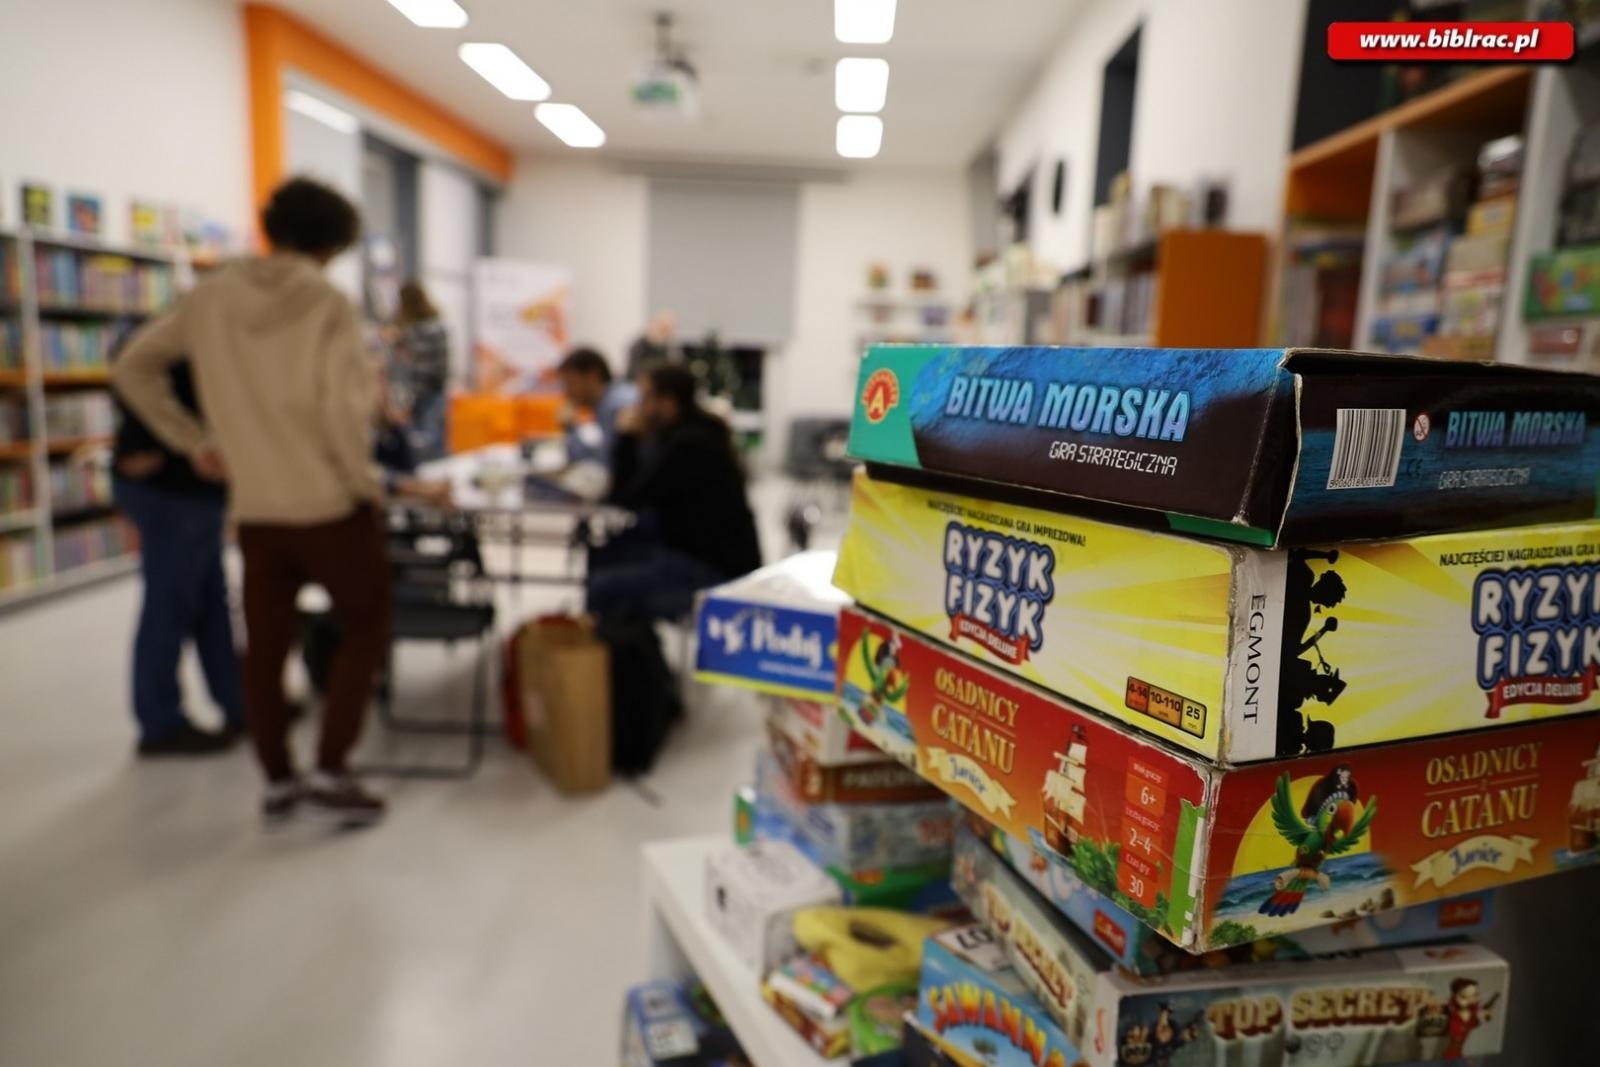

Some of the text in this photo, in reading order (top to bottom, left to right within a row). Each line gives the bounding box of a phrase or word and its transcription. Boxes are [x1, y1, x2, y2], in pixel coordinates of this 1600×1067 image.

[946, 376, 1035, 424] BITWA
[1037, 382, 1191, 442] MORSKA
[1445, 411, 1586, 448] BITWA MORSKA
[1049, 441, 1178, 476] GRA STRATEGICZNA
[1016, 519, 1031, 533] GRA
[1034, 523, 1086, 546] IMPREZOWA!
[945, 525, 1051, 596] RYZYK
[1440, 549, 1505, 567] NAJCZĘŚCIEJ
[1507, 545, 1573, 561] NAGRADZANA
[1576, 544, 1595, 556] GRA
[948, 574, 1040, 641] FIZYK
[1243, 593, 1266, 724] EGMONT
[935, 667, 1020, 727] OSADNICY
[1150, 692, 1180, 712] 10-110
[1504, 682, 1541, 699] EDYCJA
[1186, 705, 1200, 720] 25
[931, 703, 1016, 775] CATANU
[1426, 741, 1543, 785] OSADNICY
[1141, 786, 1157, 806] 6+
[1421, 783, 1539, 839] CATANU
[1128, 875, 1144, 898] 30
[1206, 986, 1424, 1041] TOP SECRET
